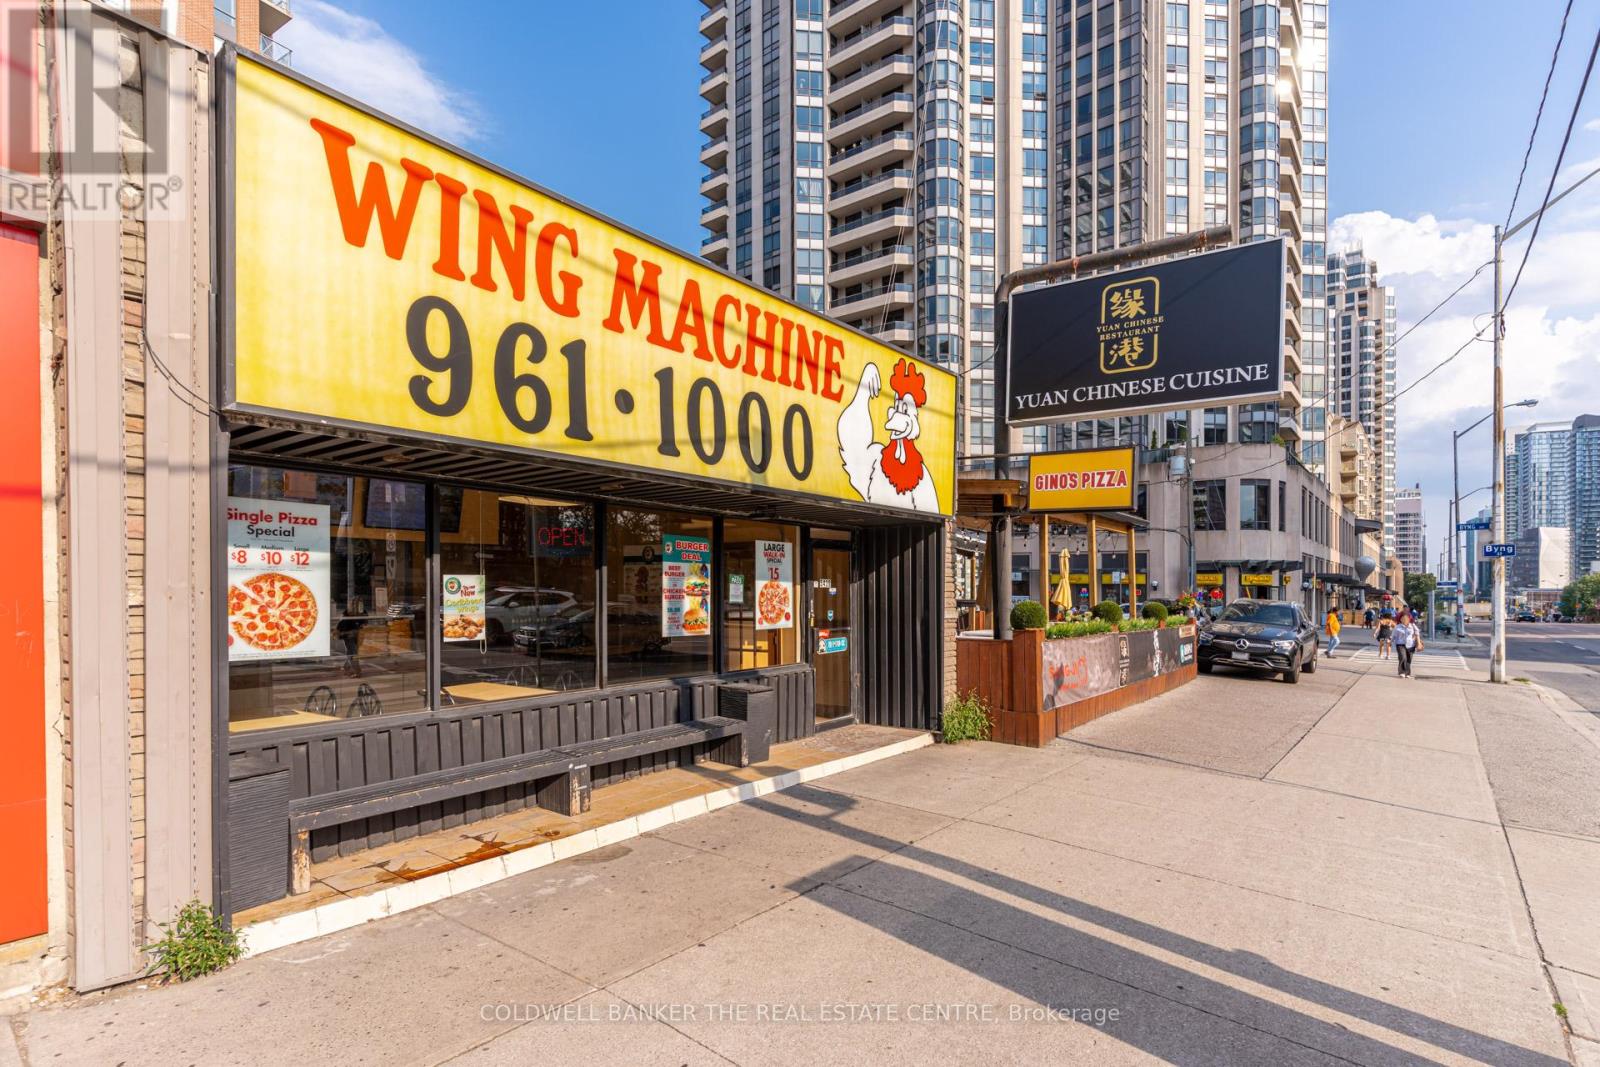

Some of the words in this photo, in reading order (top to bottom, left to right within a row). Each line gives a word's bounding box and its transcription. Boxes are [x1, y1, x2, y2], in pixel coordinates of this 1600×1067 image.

[310, 118, 583, 318] WING
[602, 248, 845, 403] MACHINE
[1097, 323, 1120, 333] YUAN
[1123, 315, 1165, 329] CHINESE
[1100, 325, 1160, 341] RESTAURANT
[1016, 389, 1069, 410] YUAN
[1073, 376, 1166, 403] CHINESE
[1169, 363, 1270, 390] CUISINE
[1034, 472, 1078, 491] GINO'S
[1081, 469, 1128, 489] PIZZA
[278, 511, 318, 526] Pizza
[246, 524, 295, 538] Special
[675, 540, 710, 552] BURGER
[763, 543, 786, 552] LARGE
[1485, 545, 1513, 553] Byng
[231, 549, 248, 564] $8
[260, 551, 282, 565] $10
[290, 552, 310, 566] $12
[681, 552, 703, 561] DEAL
[460, 589, 476, 598] New
